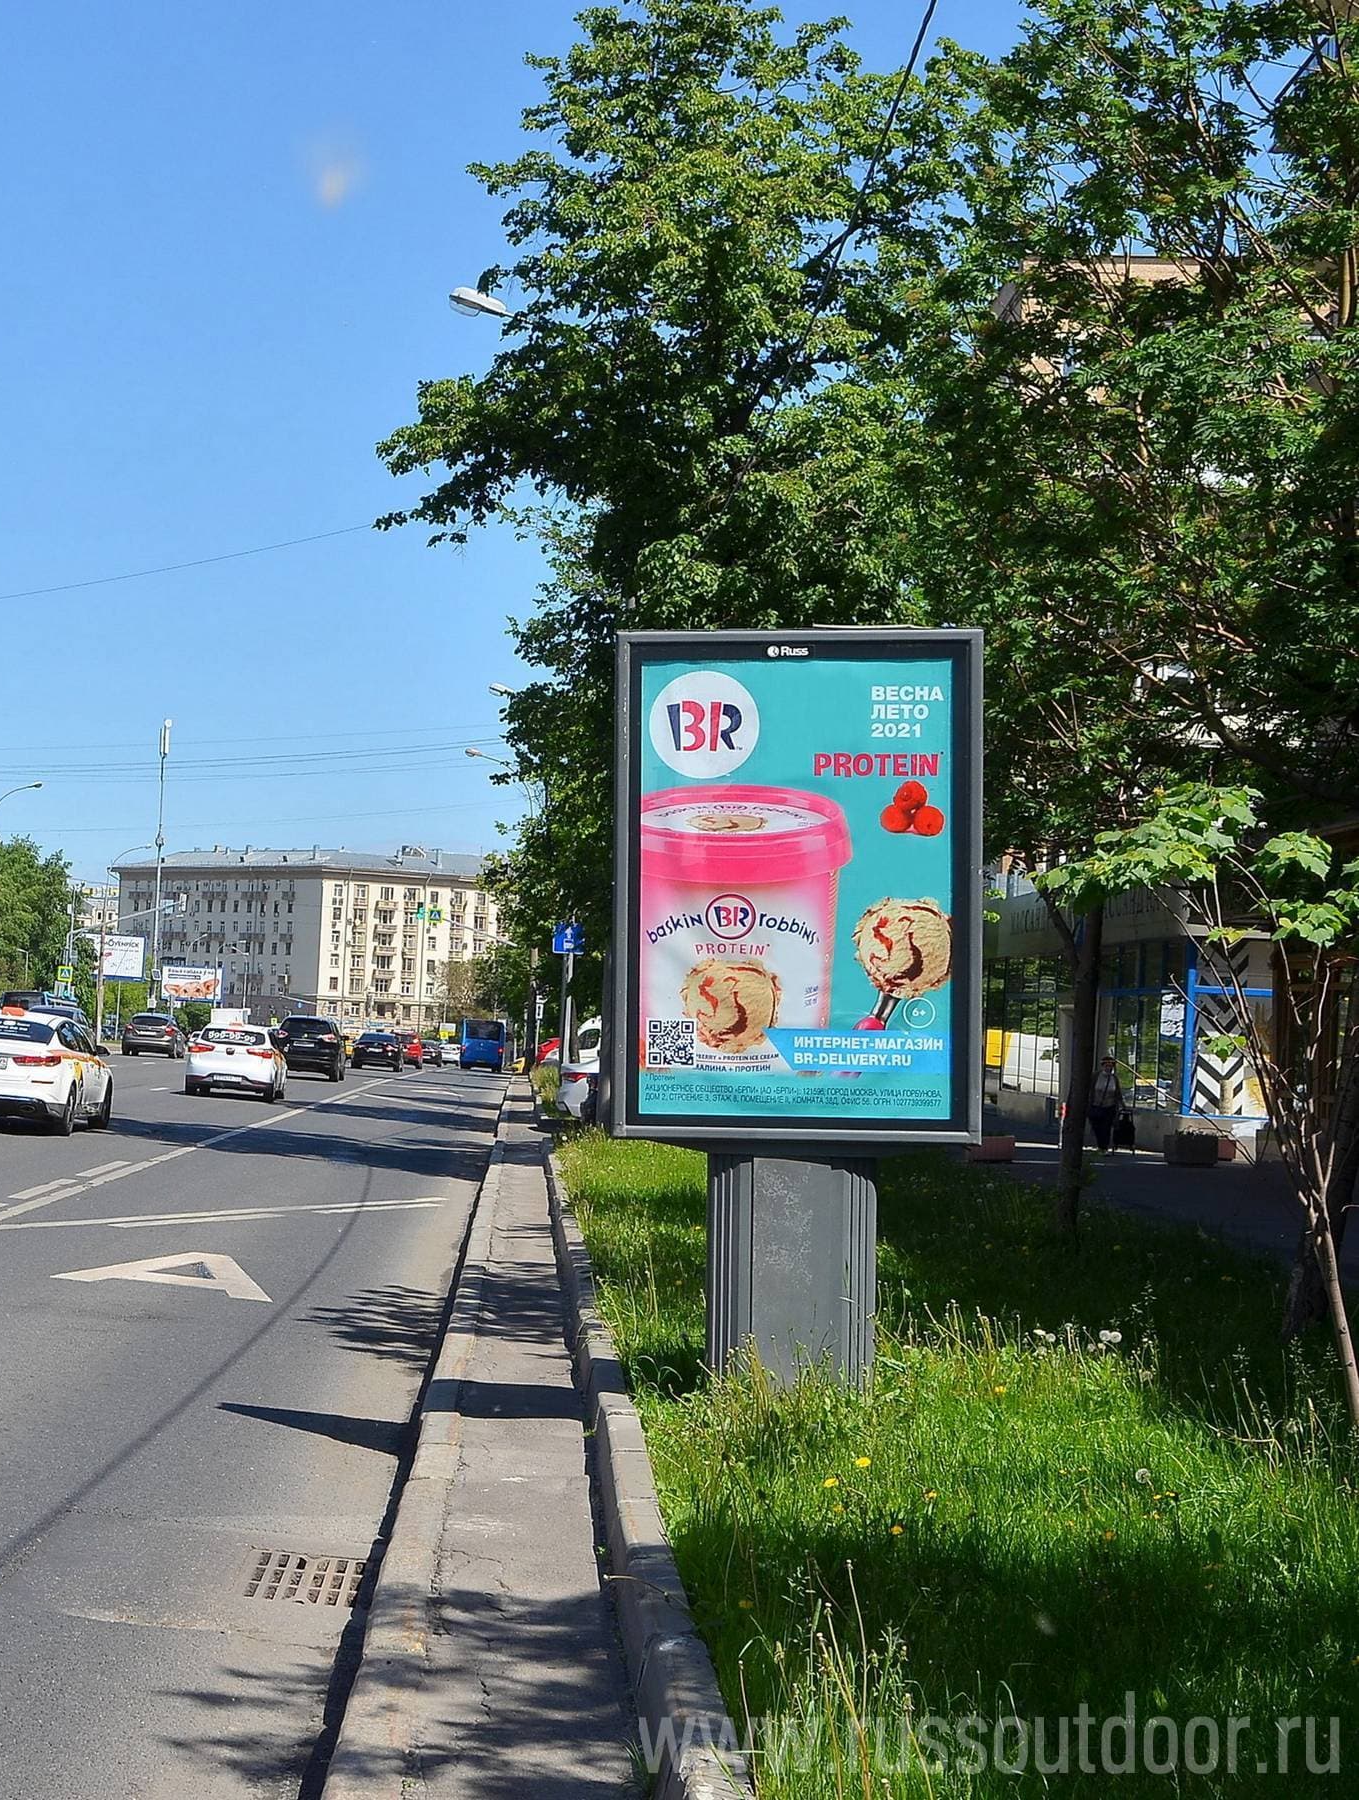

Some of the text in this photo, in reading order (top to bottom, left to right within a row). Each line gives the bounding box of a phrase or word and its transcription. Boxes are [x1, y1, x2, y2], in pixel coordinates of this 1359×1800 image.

[780, 646, 809, 657] Russ
[871, 685, 944, 701] ВЕСНА
[871, 704, 929, 720] ЛЕТО
[666, 700, 743, 752] BR
[870, 722, 922, 738] 2021
[646, 905, 818, 945] baskin BR robbins
[912, 1007, 927, 1017] 6+
[793, 1036, 944, 1051] ИНТЕРНЕТ-МАГАЗИН
[793, 1053, 912, 1066] BR-DELIVERY.RU
[735, 1065, 771, 1073] ПРОТЕИН
[645, 1084, 694, 1092] АКЦИОНЕРНОЕ
[695, 1085, 733, 1094] ОБЩЕСТВО
[826, 1087, 849, 1097] ГОРОД
[880, 1088, 902, 1098] УЛИЦА
[645, 1093, 661, 1101] ДОМ
[669, 1093, 703, 1102] СТРОЕНИЕ
[712, 1094, 731, 1102] ЭТАЖ
[740, 1095, 784, 1103] ПОМЕЩЕНИЕ
[792, 1096, 823, 1104] КОМНАТА
[841, 1097, 861, 1105] ОФИС
[873, 1097, 891, 1105] ОГРН
